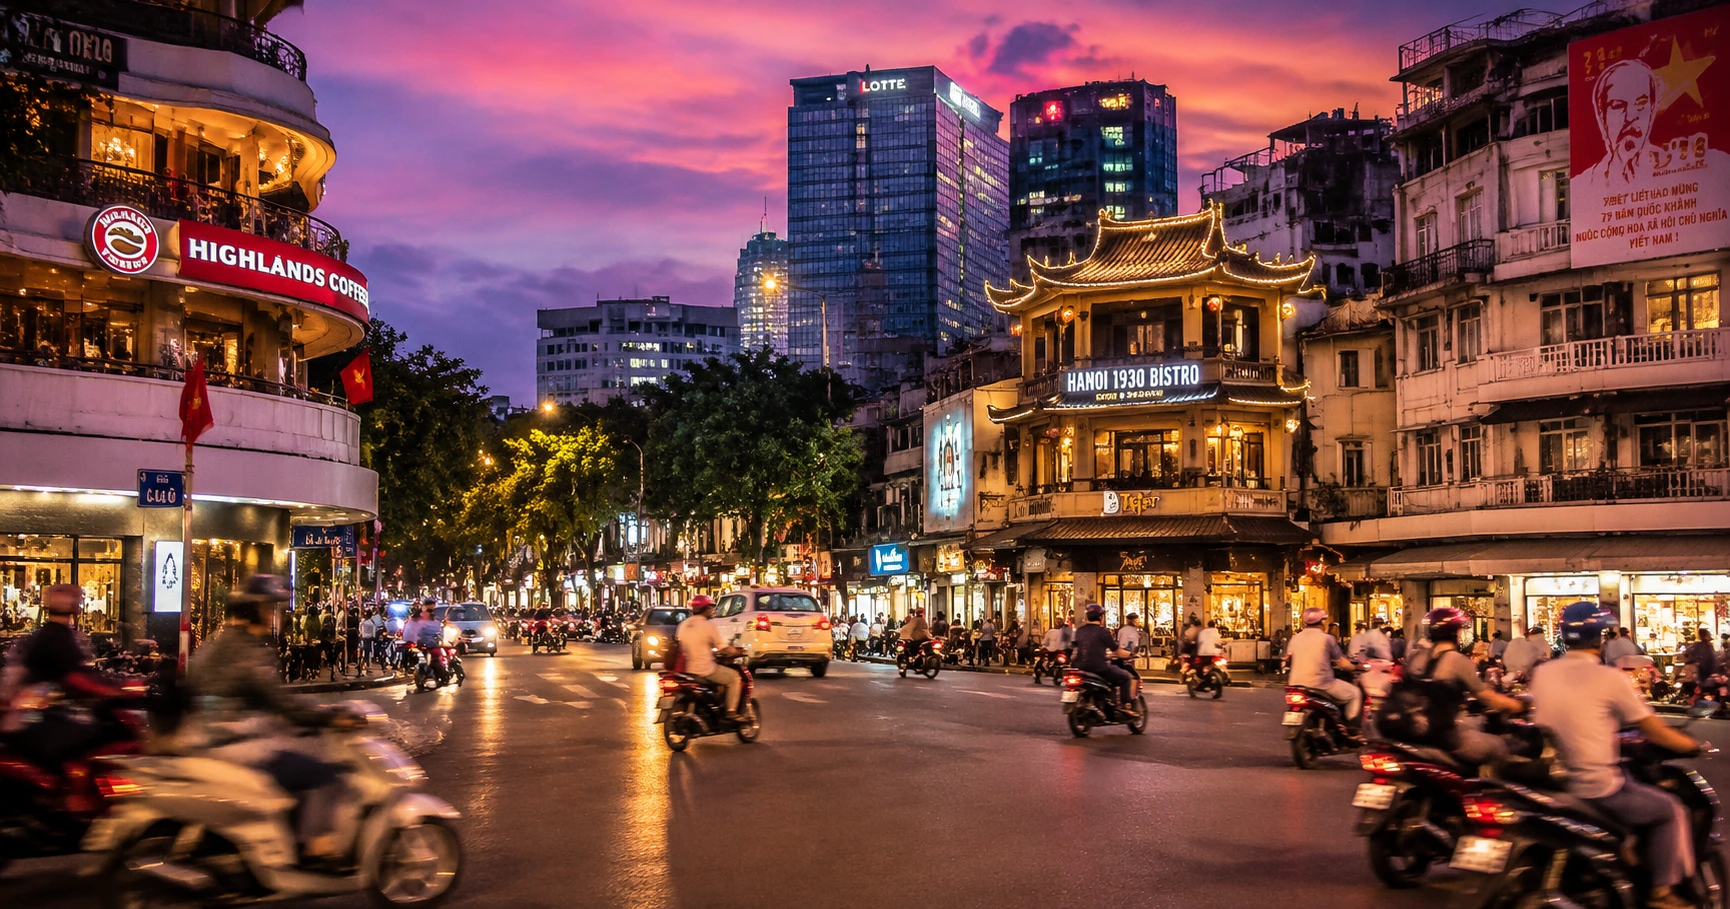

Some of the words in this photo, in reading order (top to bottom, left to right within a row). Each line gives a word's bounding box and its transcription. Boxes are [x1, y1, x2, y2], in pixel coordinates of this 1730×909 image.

[861, 78, 906, 92] LOTTE
[1652, 233, 1673, 246] NAM
[1067, 370, 1108, 392] HANOI
[1113, 368, 1145, 389] 1930
